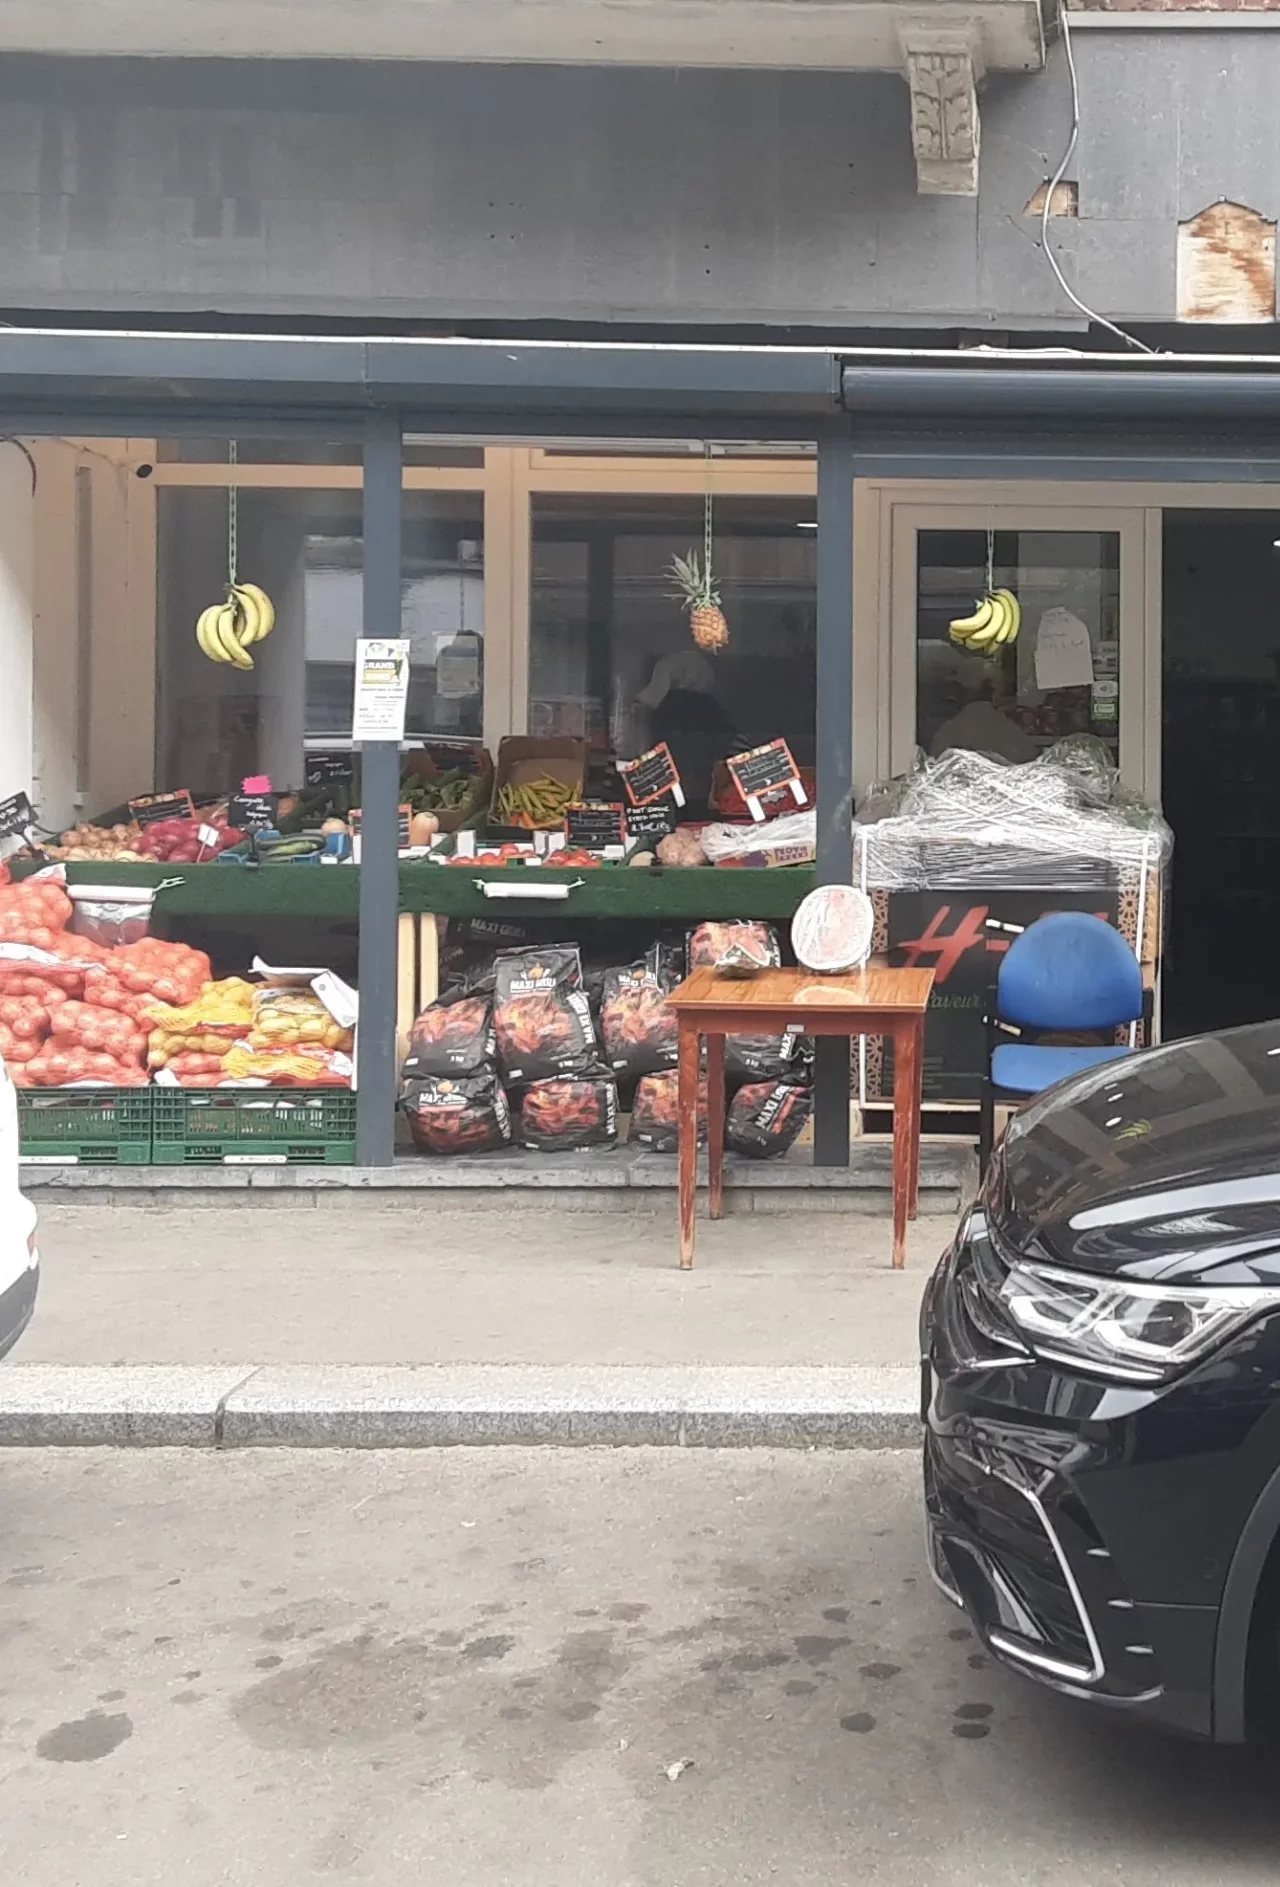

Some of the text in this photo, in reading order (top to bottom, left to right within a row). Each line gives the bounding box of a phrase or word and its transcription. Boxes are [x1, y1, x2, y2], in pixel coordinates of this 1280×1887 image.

[510, 979, 535, 989] MAXI
[779, 1033, 793, 1060] MAX
[755, 1099, 779, 1129] MAXI
